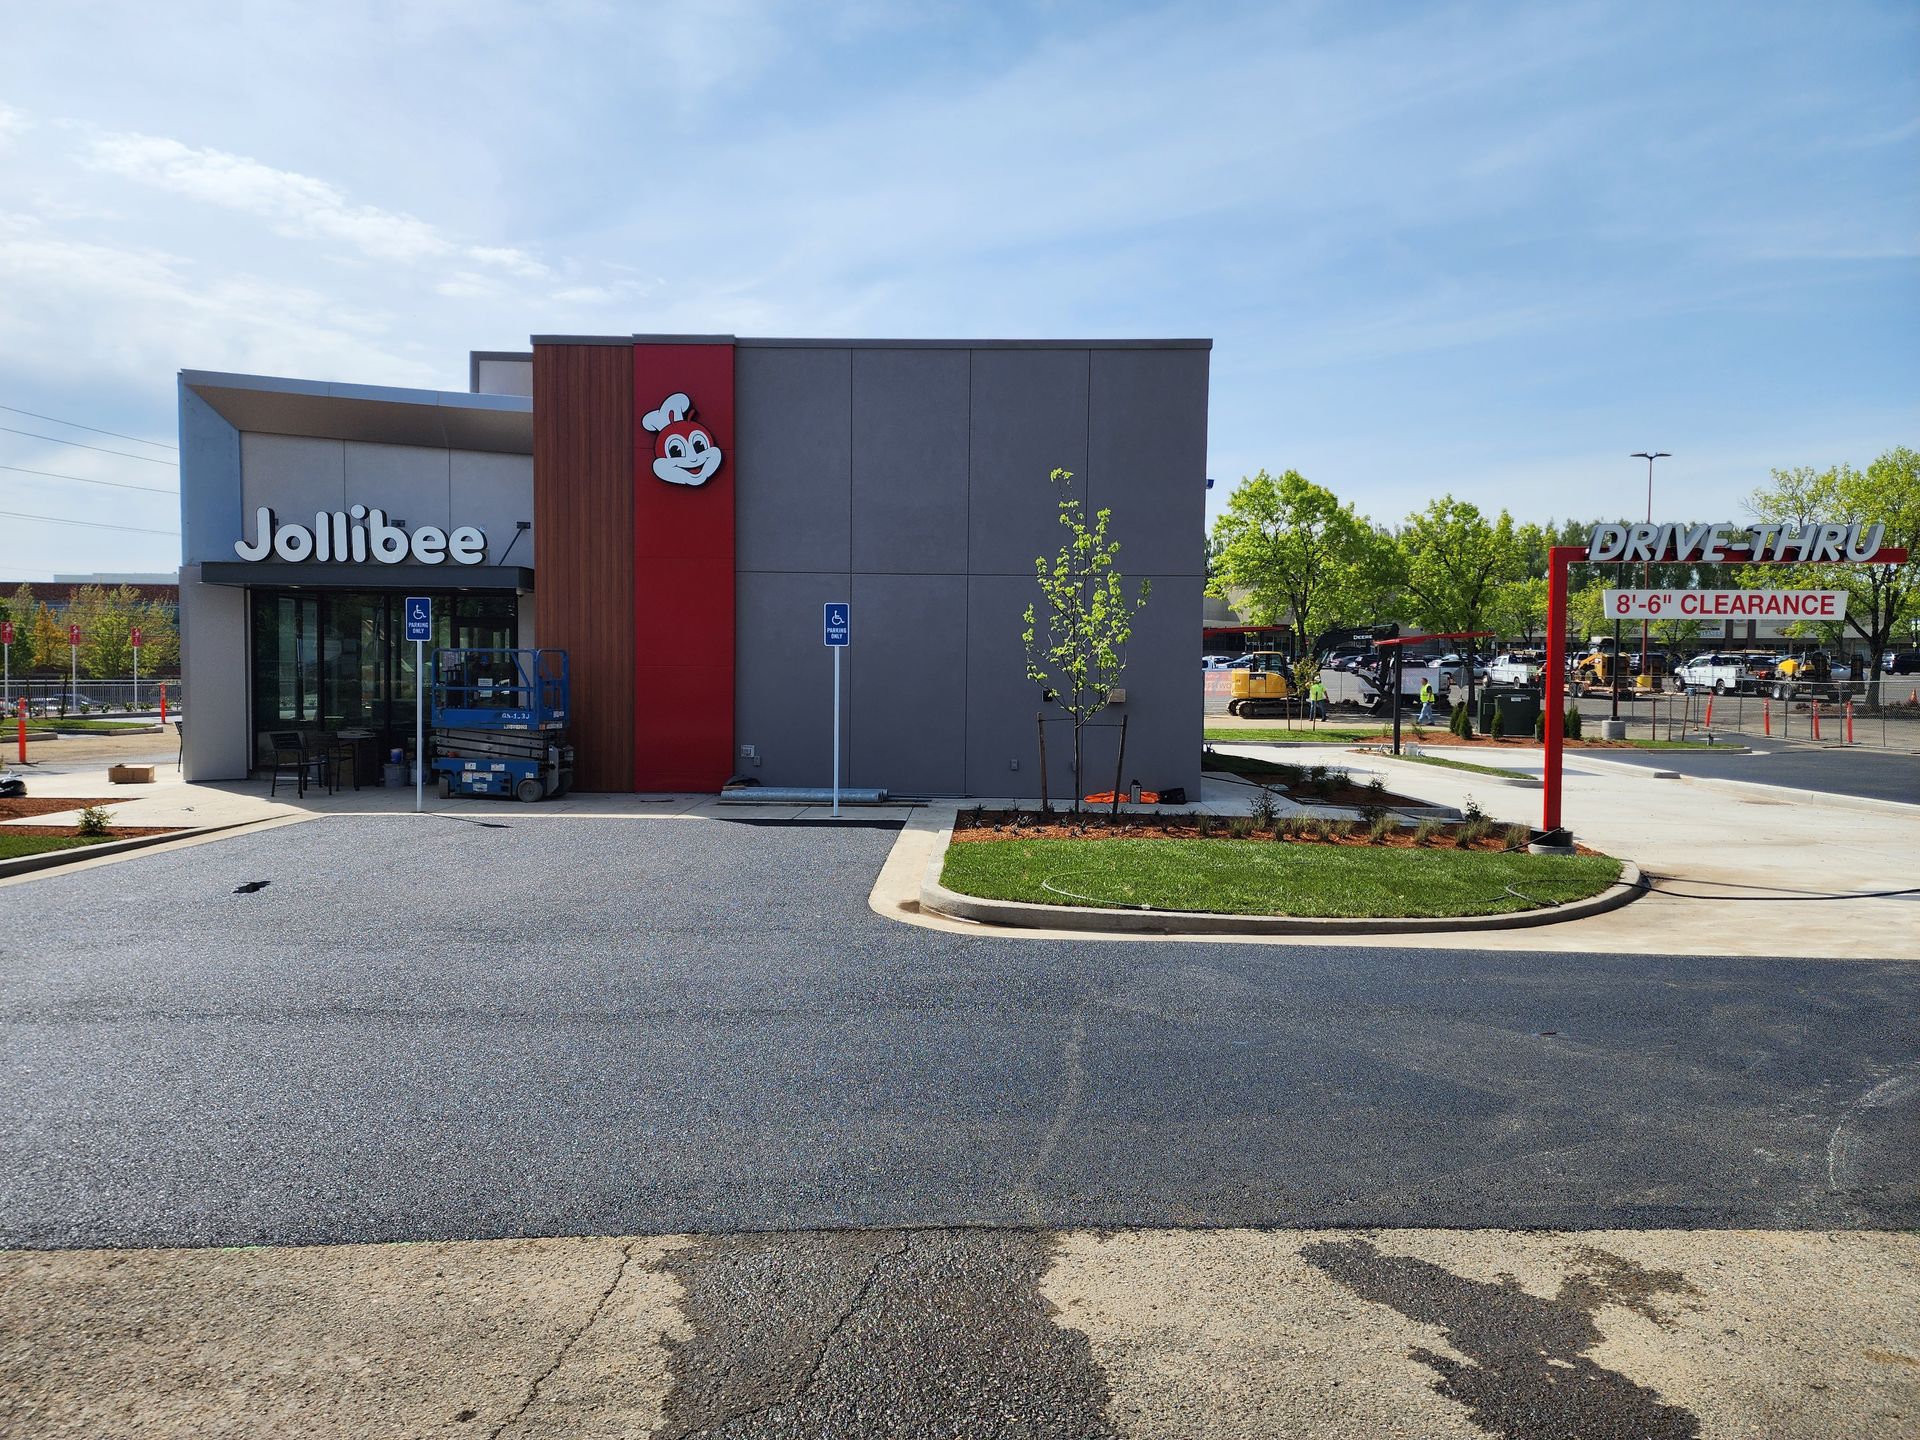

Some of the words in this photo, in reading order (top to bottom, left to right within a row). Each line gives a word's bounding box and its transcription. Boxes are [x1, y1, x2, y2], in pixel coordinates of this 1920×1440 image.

[234, 504, 487, 565] Jollibee
[1588, 523, 1885, 562] DRIVE-THRU
[1616, 594, 1672, 614] 8'-6"
[1681, 594, 1835, 615] CLEARANCE
